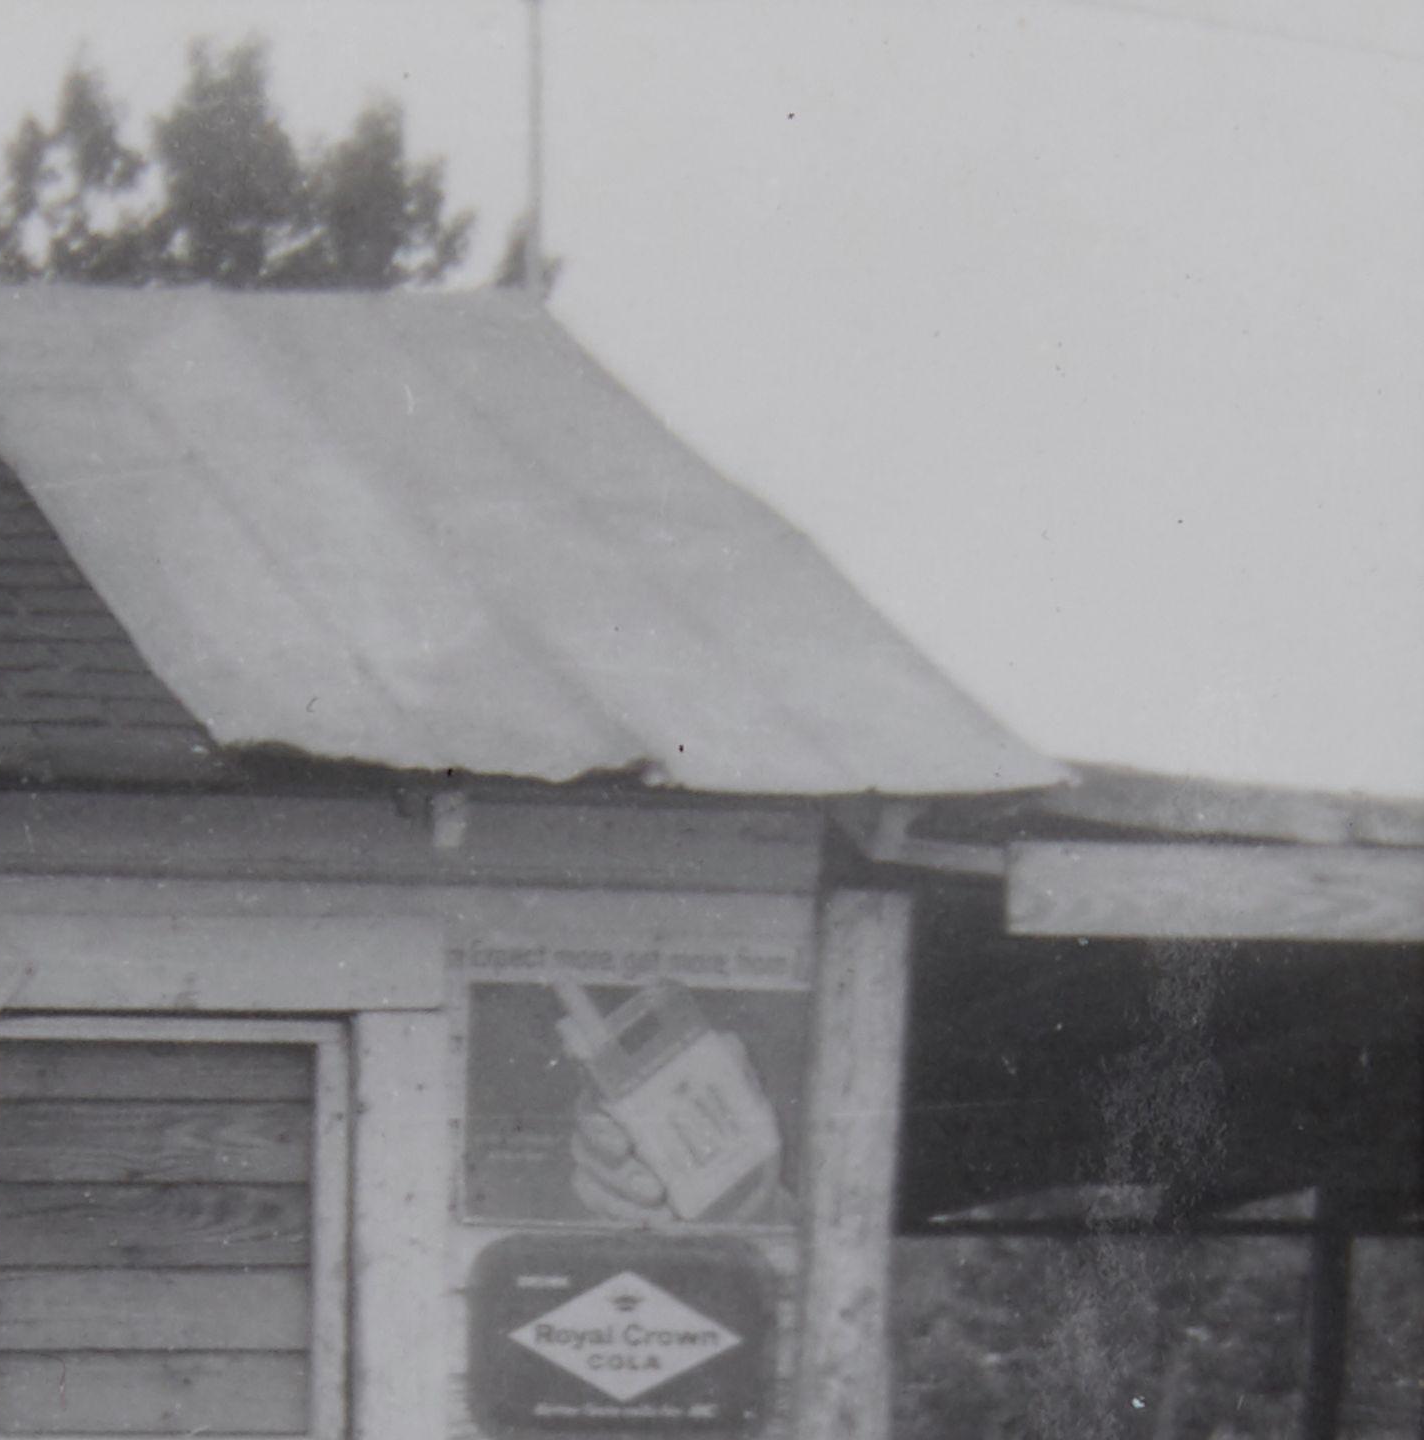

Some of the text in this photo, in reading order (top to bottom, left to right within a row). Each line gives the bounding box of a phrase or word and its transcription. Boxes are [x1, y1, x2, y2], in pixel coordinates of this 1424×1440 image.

[534, 1323, 719, 1350] Royal Crown
[587, 1354, 662, 1371] COLA
